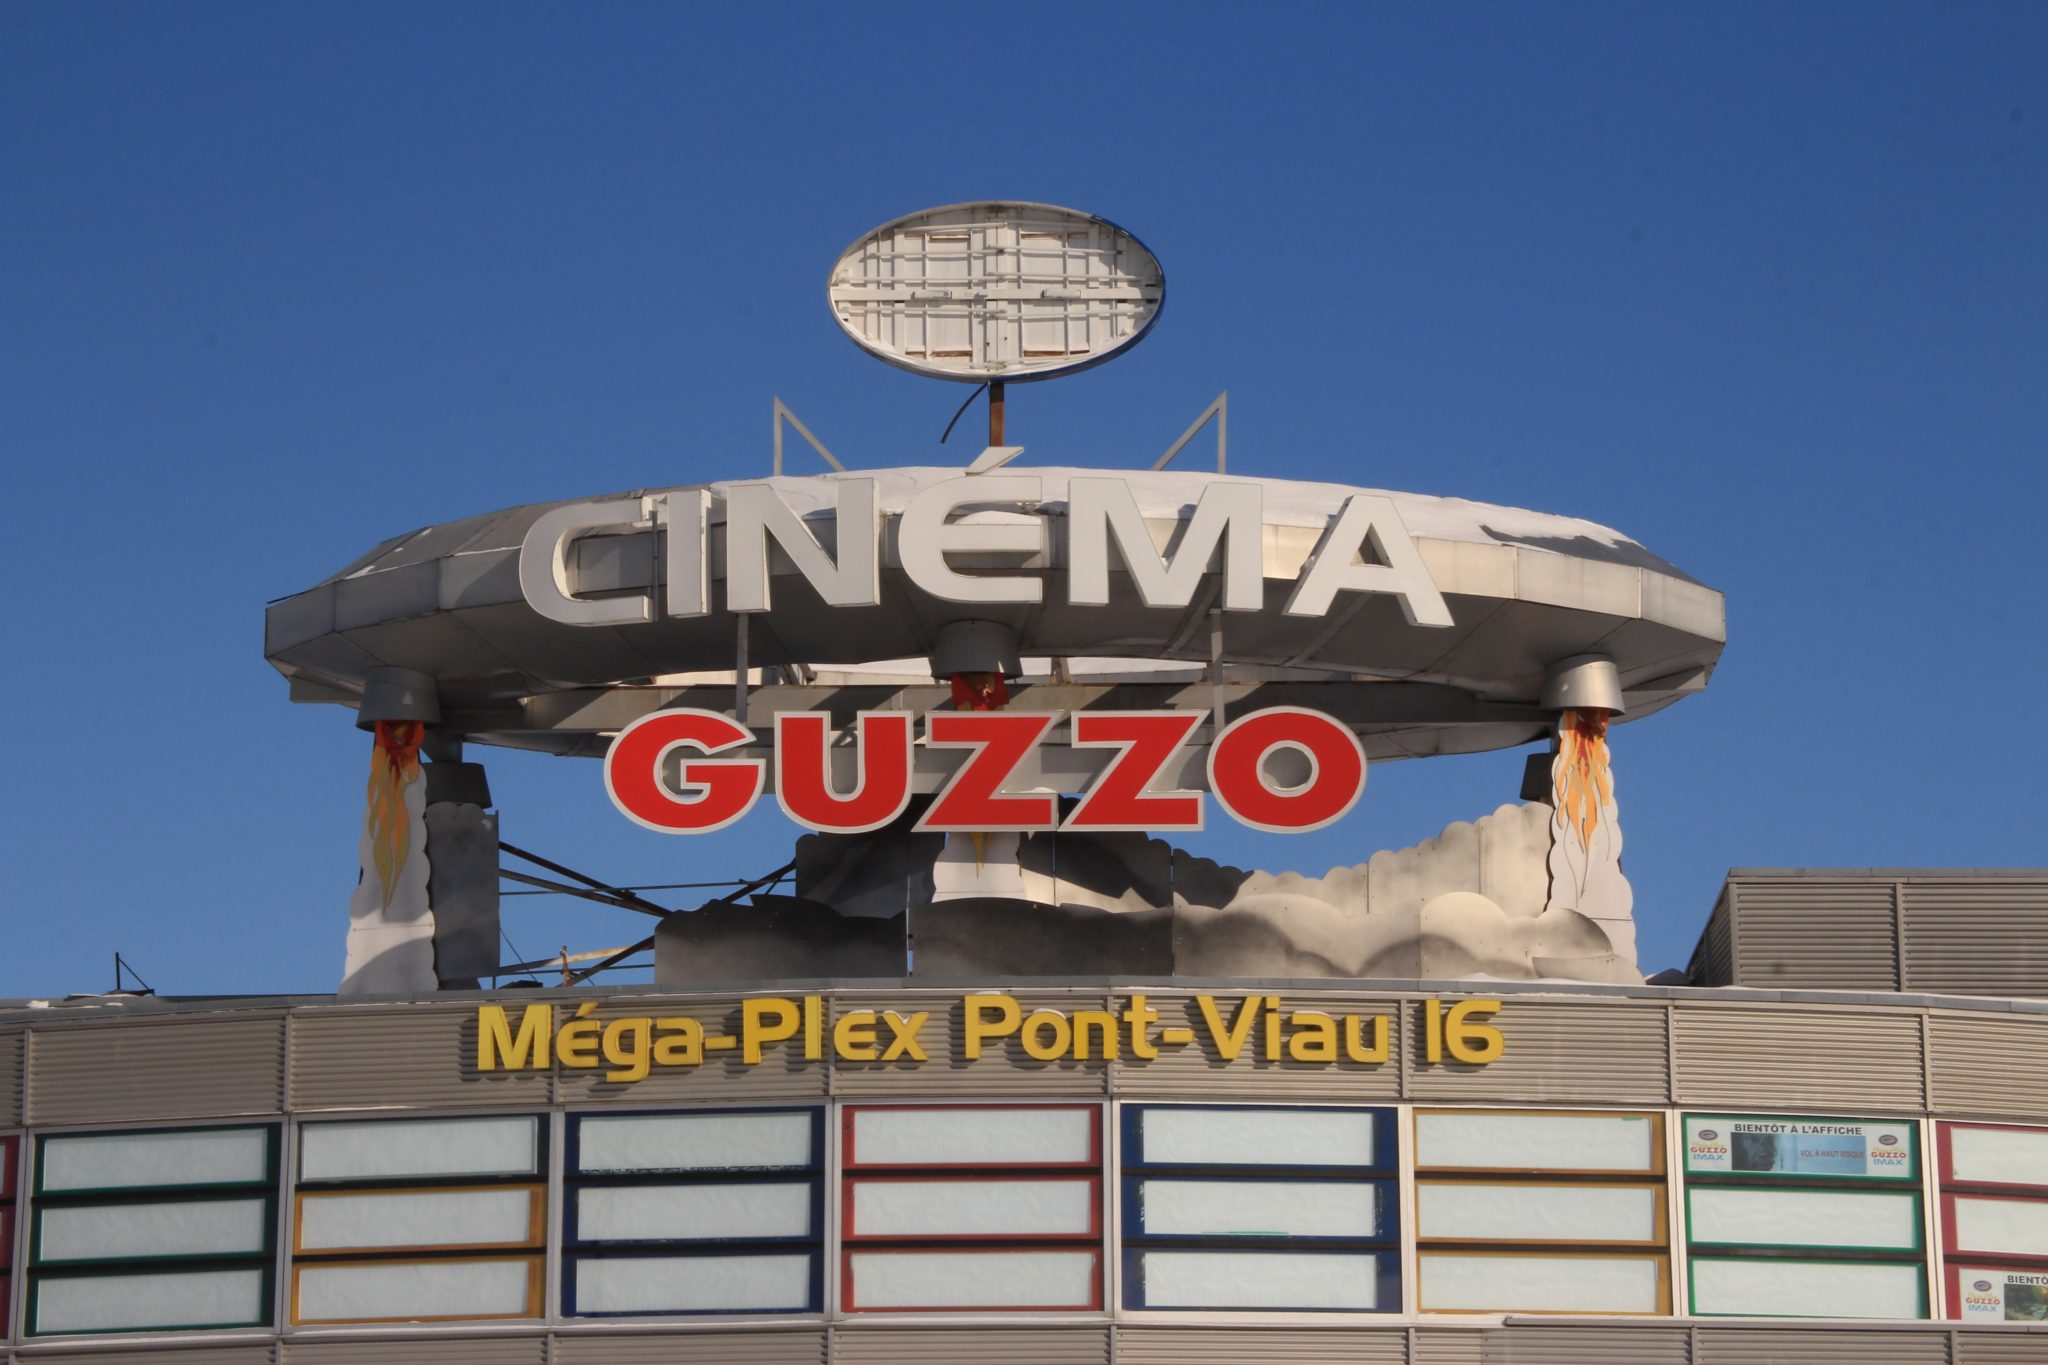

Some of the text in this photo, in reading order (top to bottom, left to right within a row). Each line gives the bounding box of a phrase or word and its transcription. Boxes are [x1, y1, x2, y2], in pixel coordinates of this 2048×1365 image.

[519, 446, 1455, 627] CINÉMA
[604, 705, 1367, 834] GUZZO
[477, 993, 1505, 1082] Méga-Plex Pont-Viau 16
[1734, 1123, 1862, 1135] BIENTÔT À L'AFFICHE
[1690, 1146, 1727, 1154] GUZZO
[1693, 1153, 1724, 1161] IMAX
[1871, 1151, 1907, 1159] GUZZO
[1873, 1158, 1903, 1166] IMAX
[1965, 1297, 2000, 1305] GUZZO
[1968, 1304, 1997, 1312] IMAX
